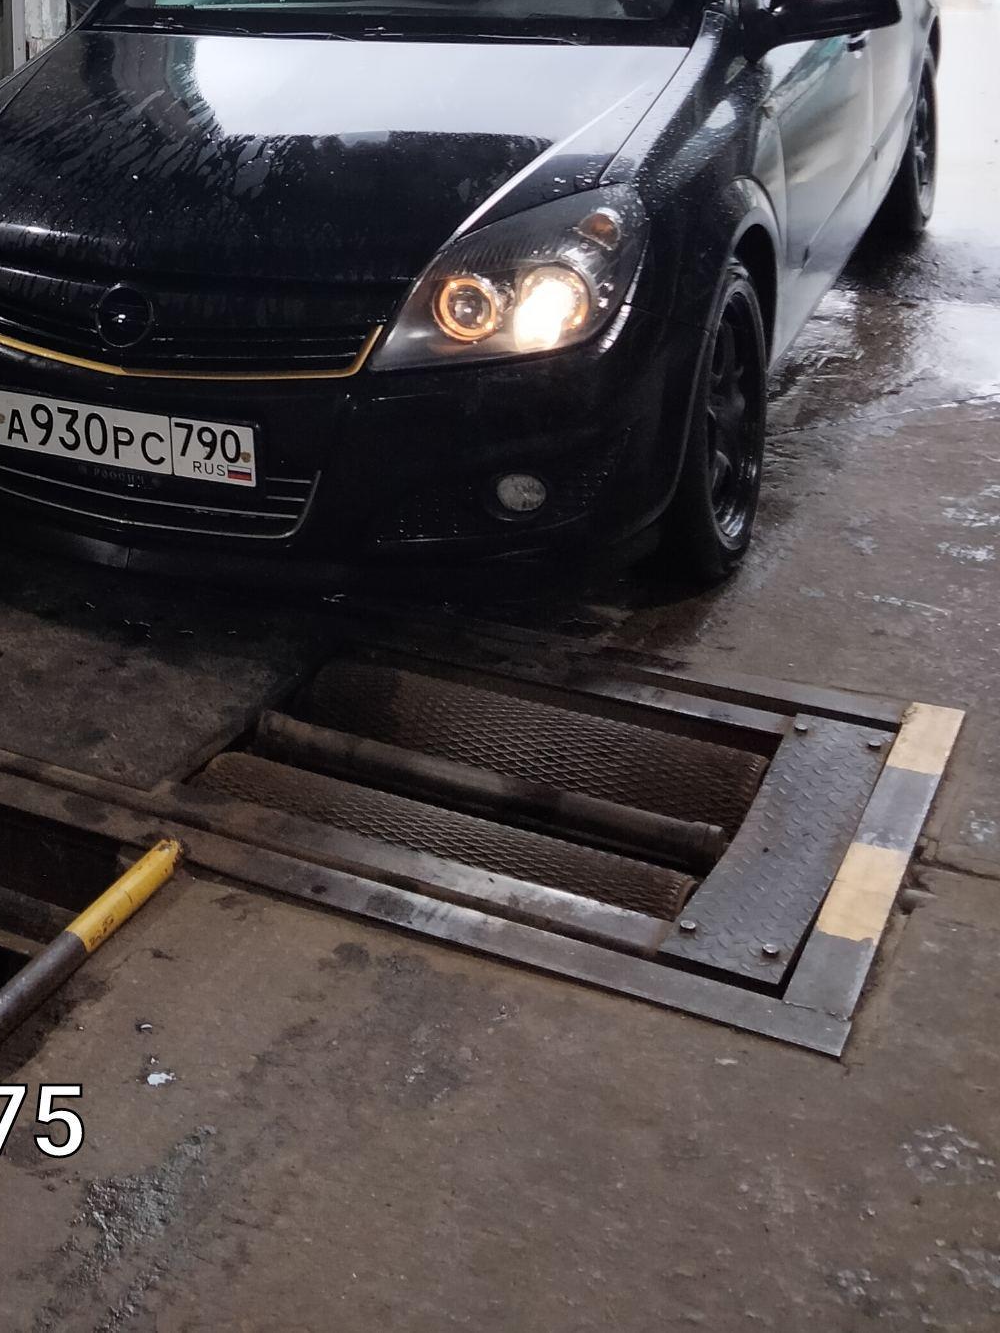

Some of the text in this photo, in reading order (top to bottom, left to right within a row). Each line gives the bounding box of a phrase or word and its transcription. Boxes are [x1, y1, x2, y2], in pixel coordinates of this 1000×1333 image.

[7, 403, 242, 465] А930РС 790
[192, 461, 226, 477] RUS
